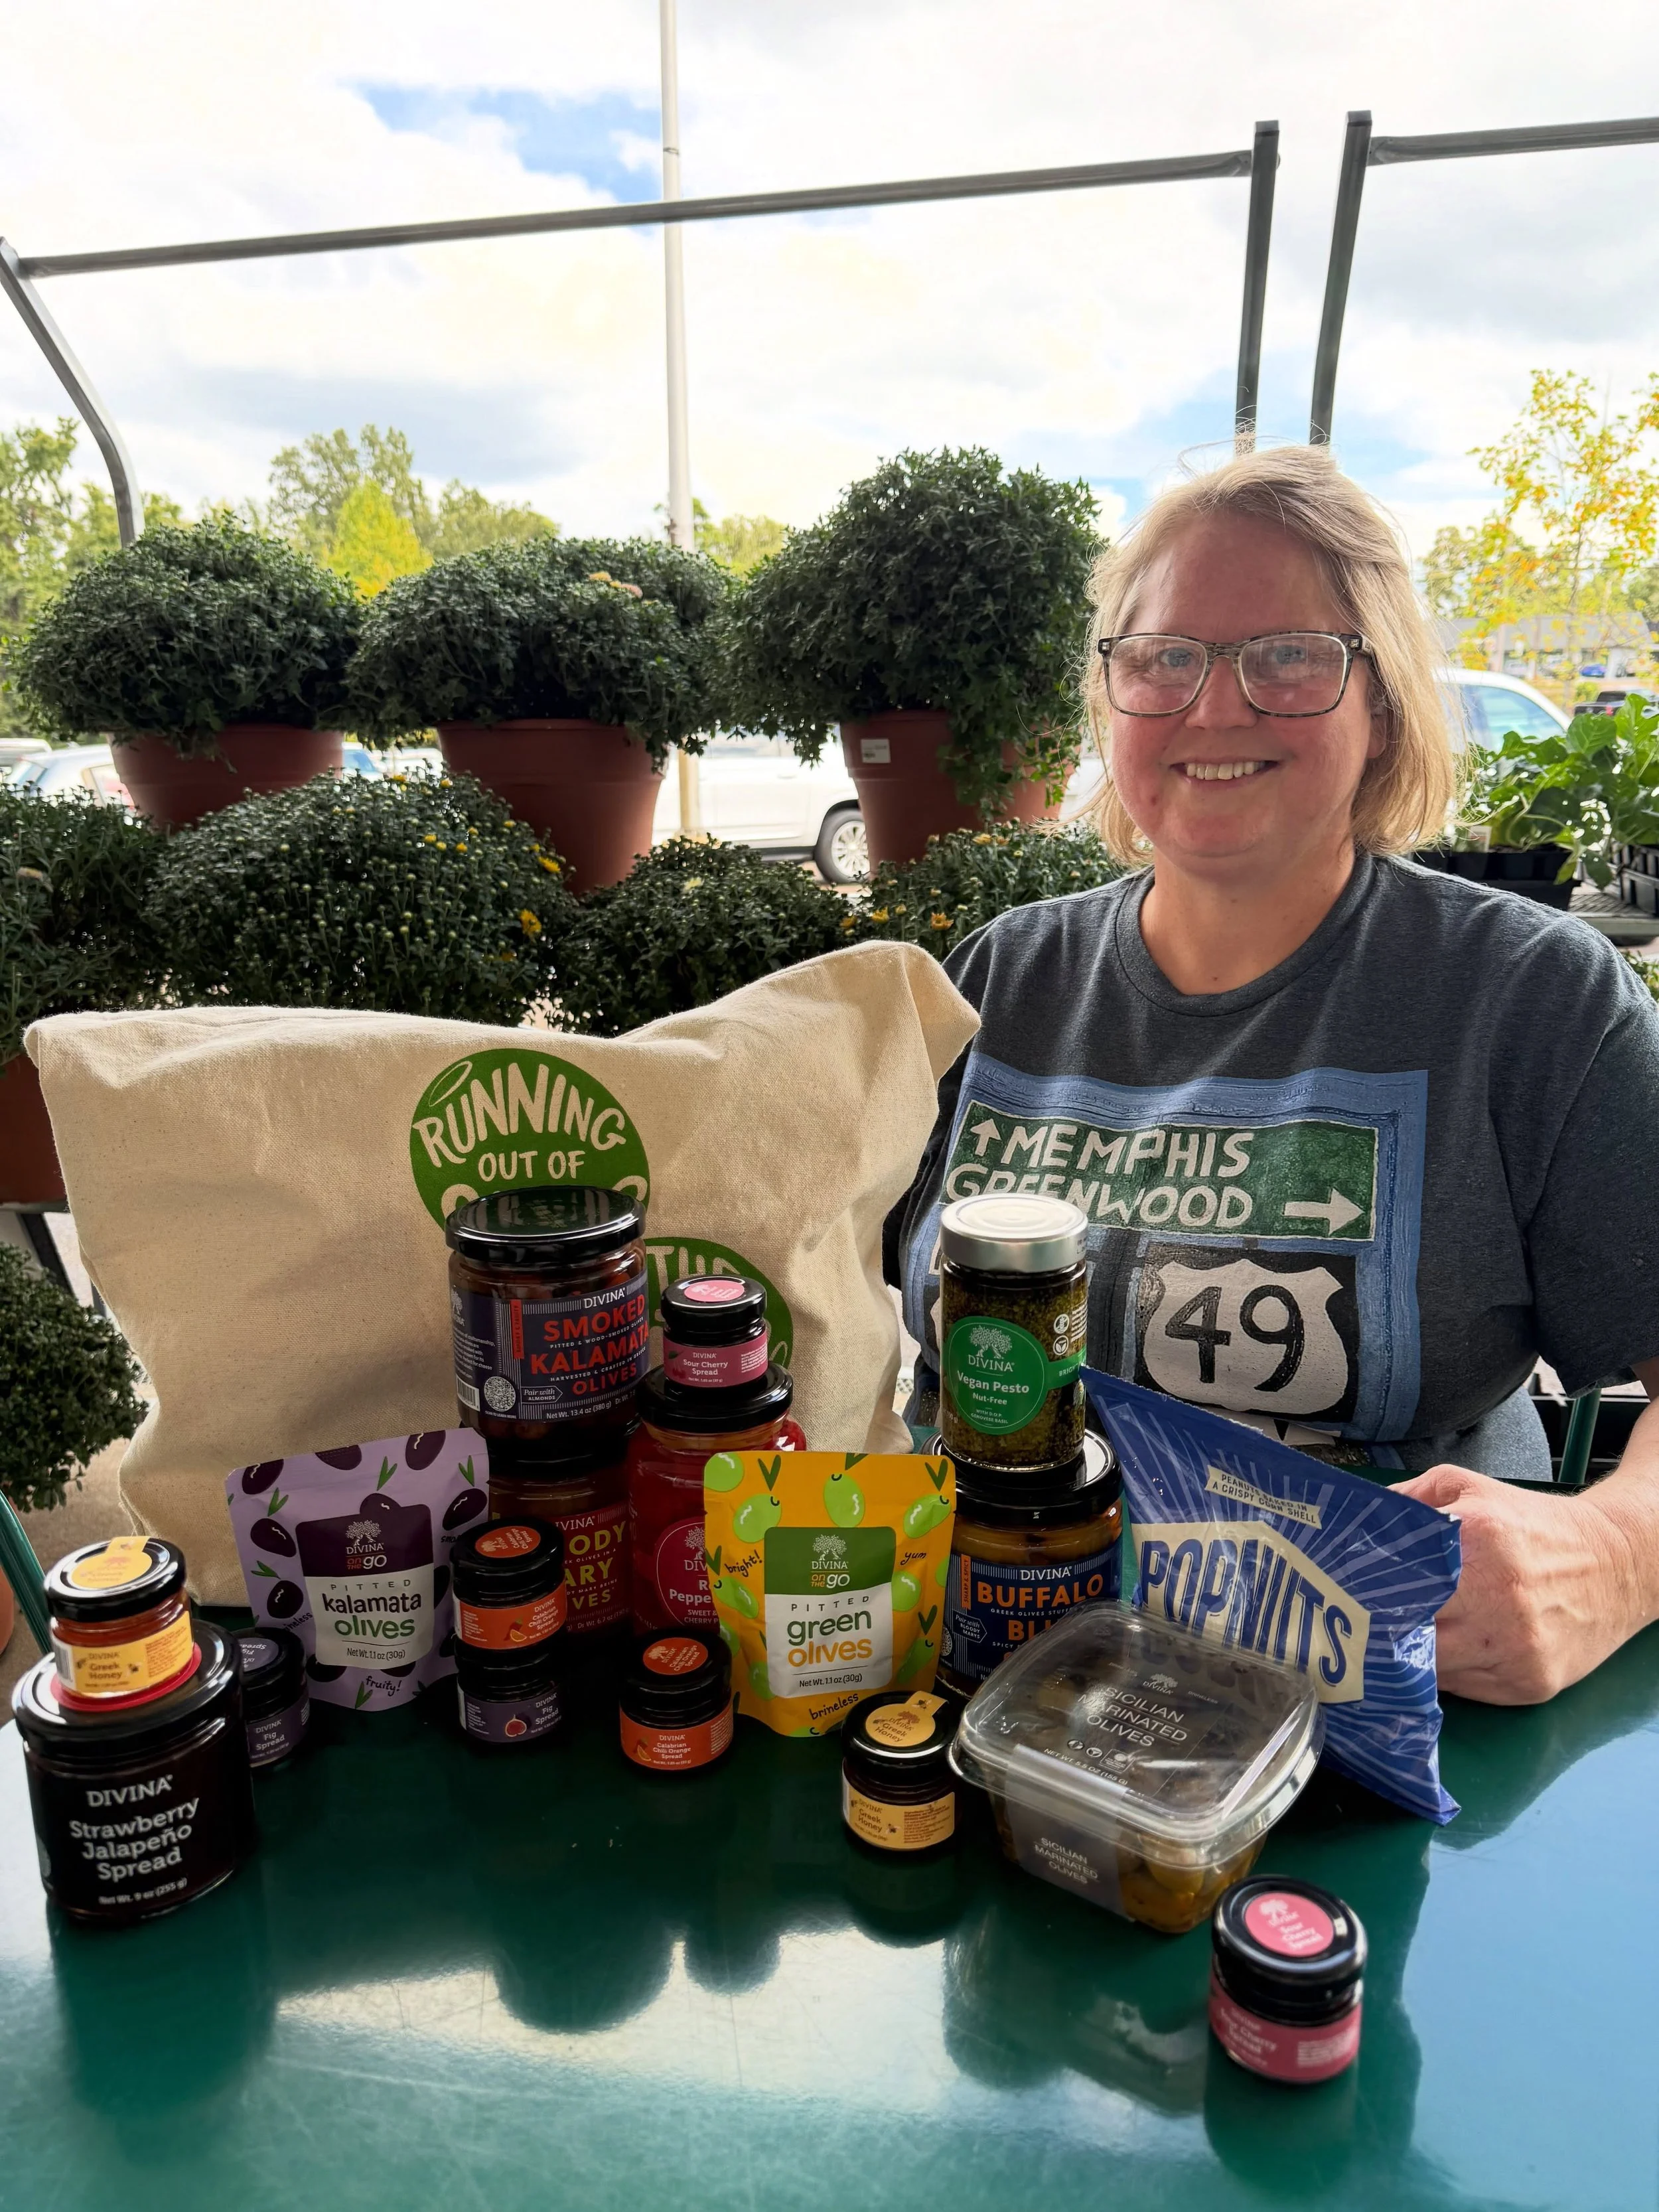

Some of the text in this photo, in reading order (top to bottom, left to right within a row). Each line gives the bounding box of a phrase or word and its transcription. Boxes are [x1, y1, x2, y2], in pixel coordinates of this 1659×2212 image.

[412, 1063, 626, 1167] RUNNING
[1001, 1124, 1254, 1178] MEMPHIS
[478, 1151, 586, 1182] OUT OF
[584, 1288, 625, 1309] DIVINA
[543, 1294, 645, 1341] SMOKED
[585, 1326, 630, 1345] WOOD-SMOKED
[1165, 1285, 1305, 1392] 49
[530, 1322, 649, 1375] KALAMATA
[550, 1371, 591, 1382] HARVESTED
[601, 1361, 625, 1372] CRAFTED
[968, 1355, 1013, 1372] DIVINA
[572, 1363, 637, 1395] OLIVES
[958, 1370, 1029, 1393] Vegan Pesto
[540, 1386, 555, 1395] with
[973, 1392, 1007, 1404] Nut-Free
[1222, 1473, 1307, 1512] PEANUTS BAKED IN
[1222, 1485, 1254, 1502] CRISPY
[1259, 1498, 1283, 1512] CORN
[1287, 1508, 1316, 1523] SHELL
[555, 1516, 595, 1530] IVINA
[569, 1520, 626, 1555] ODY
[346, 1543, 384, 1554] DIVINA
[363, 1554, 388, 1570] go
[576, 1554, 601, 1564] OLIVES
[684, 1560, 707, 1572] DIV
[725, 1550, 762, 1578] bright!
[812, 1560, 849, 1570] DIVINA
[901, 1551, 927, 1566] yum
[564, 1557, 613, 1587] ARY
[1020, 1566, 1072, 1580] DIVINA
[330, 1579, 411, 1591] PITTED
[826, 1574, 850, 1588] go
[572, 1589, 611, 1610] VES
[670, 1589, 712, 1606] Peppe
[977, 1574, 1104, 1609] BUFFALO
[322, 1593, 421, 1613] kalamata
[534, 1597, 555, 1613] DIVINA
[791, 1595, 870, 1612] PITTED
[283, 1611, 313, 1631] ineless
[529, 1609, 559, 1627] Chili Orange
[533, 1606, 556, 1621] Calabrian
[955, 1615, 967, 1624] Pair
[1141, 1539, 1352, 1687] POPNUTS
[334, 1615, 415, 1639] olives
[537, 1617, 554, 1630] Spread
[786, 1609, 872, 1646] green
[960, 1623, 980, 1633] BLOODY
[963, 1629, 980, 1639] MARYS
[347, 1648, 358, 1657] Net
[358, 1649, 369, 1658] Wt.
[386, 1651, 405, 1660] (30g)
[788, 1639, 873, 1667] olives
[90, 1671, 122, 1680] Honey
[799, 1678, 812, 1688] Net
[813, 1678, 824, 1686] Wt.
[843, 1673, 863, 1684] (30g)
[366, 1675, 402, 1697] fruity!
[1142, 1681, 1173, 1695] DIVINA
[536, 1692, 557, 1708] DIVINA
[809, 1693, 859, 1720] brineless
[1105, 1687, 1185, 1723] SICILIAN
[536, 1708, 559, 1725] Spread
[541, 1705, 553, 1714] Fig
[256, 1720, 281, 1733] DIVINA
[883, 1722, 908, 1737] Greek
[888, 1718, 912, 1731] DIVINA
[1086, 1715, 1155, 1747] OLIVES
[256, 1734, 285, 1751] Spread
[264, 1732, 277, 1741] Fig
[875, 1726, 902, 1742] Honey
[1044, 1748, 1060, 1757] NET
[86, 1776, 173, 1807] DIVINA
[69, 1797, 199, 1839] Strawberry
[858, 1815, 882, 1833] Honey
[859, 1808, 881, 1824] Greek
[81, 1824, 192, 1860] Jalapeño
[1041, 1837, 1087, 1864] SICILIAN
[97, 1846, 182, 1883] Spread
[1035, 1844, 1098, 1879] MARINATED
[1049, 1861, 1088, 1883] OLIVES
[98, 1895, 115, 1905] Net
[116, 1894, 133, 1904] Wt.
[134, 1892, 141, 1901] 9
[143, 1890, 155, 1899] oz
